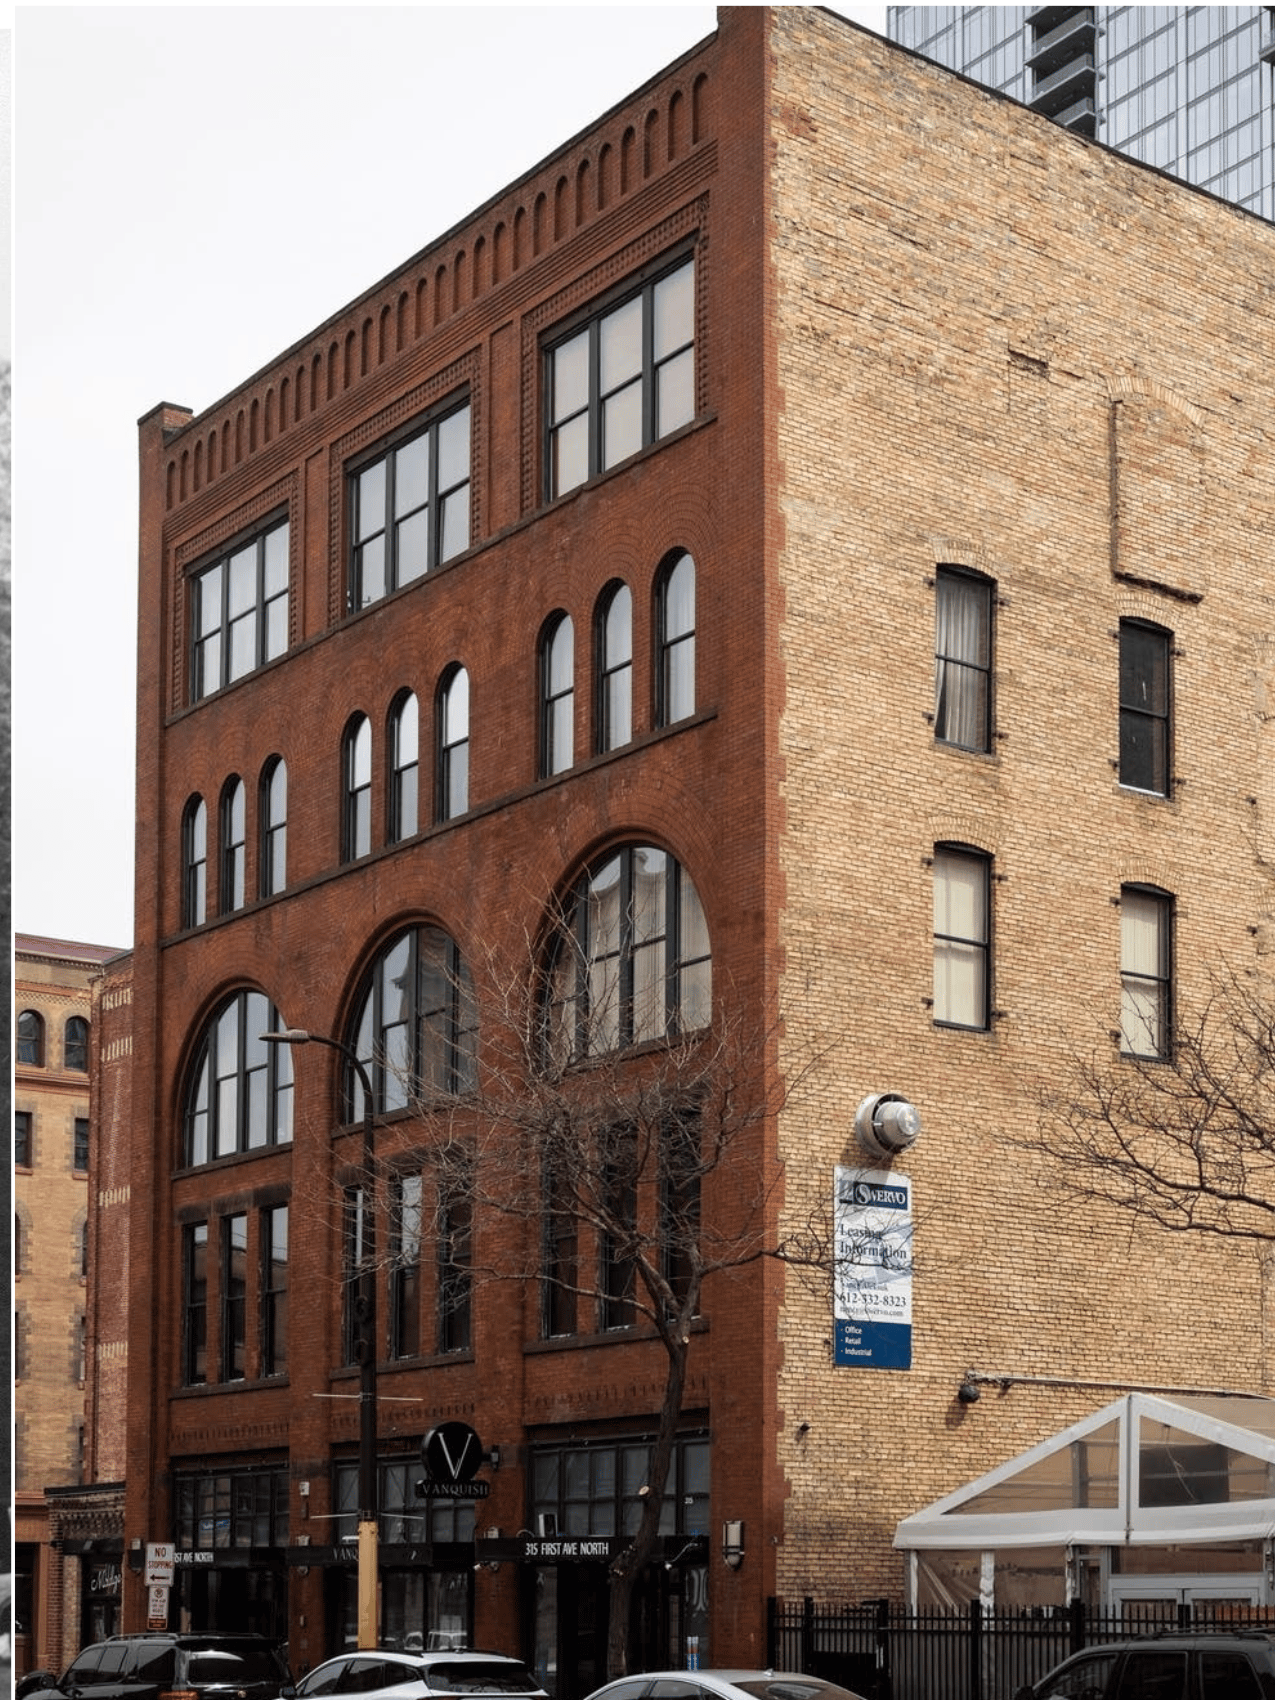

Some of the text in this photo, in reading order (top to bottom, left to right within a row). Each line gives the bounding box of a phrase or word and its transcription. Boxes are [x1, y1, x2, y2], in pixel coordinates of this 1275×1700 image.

[854, 1184, 907, 1205] SWERVO
[437, 1432, 473, 1480] V
[422, 1484, 489, 1498] VANQUISH
[154, 1546, 167, 1558] NO
[525, 1542, 609, 1556] 315 FIRST AVE NORTH
[194, 1551, 214, 1563] NORTH
